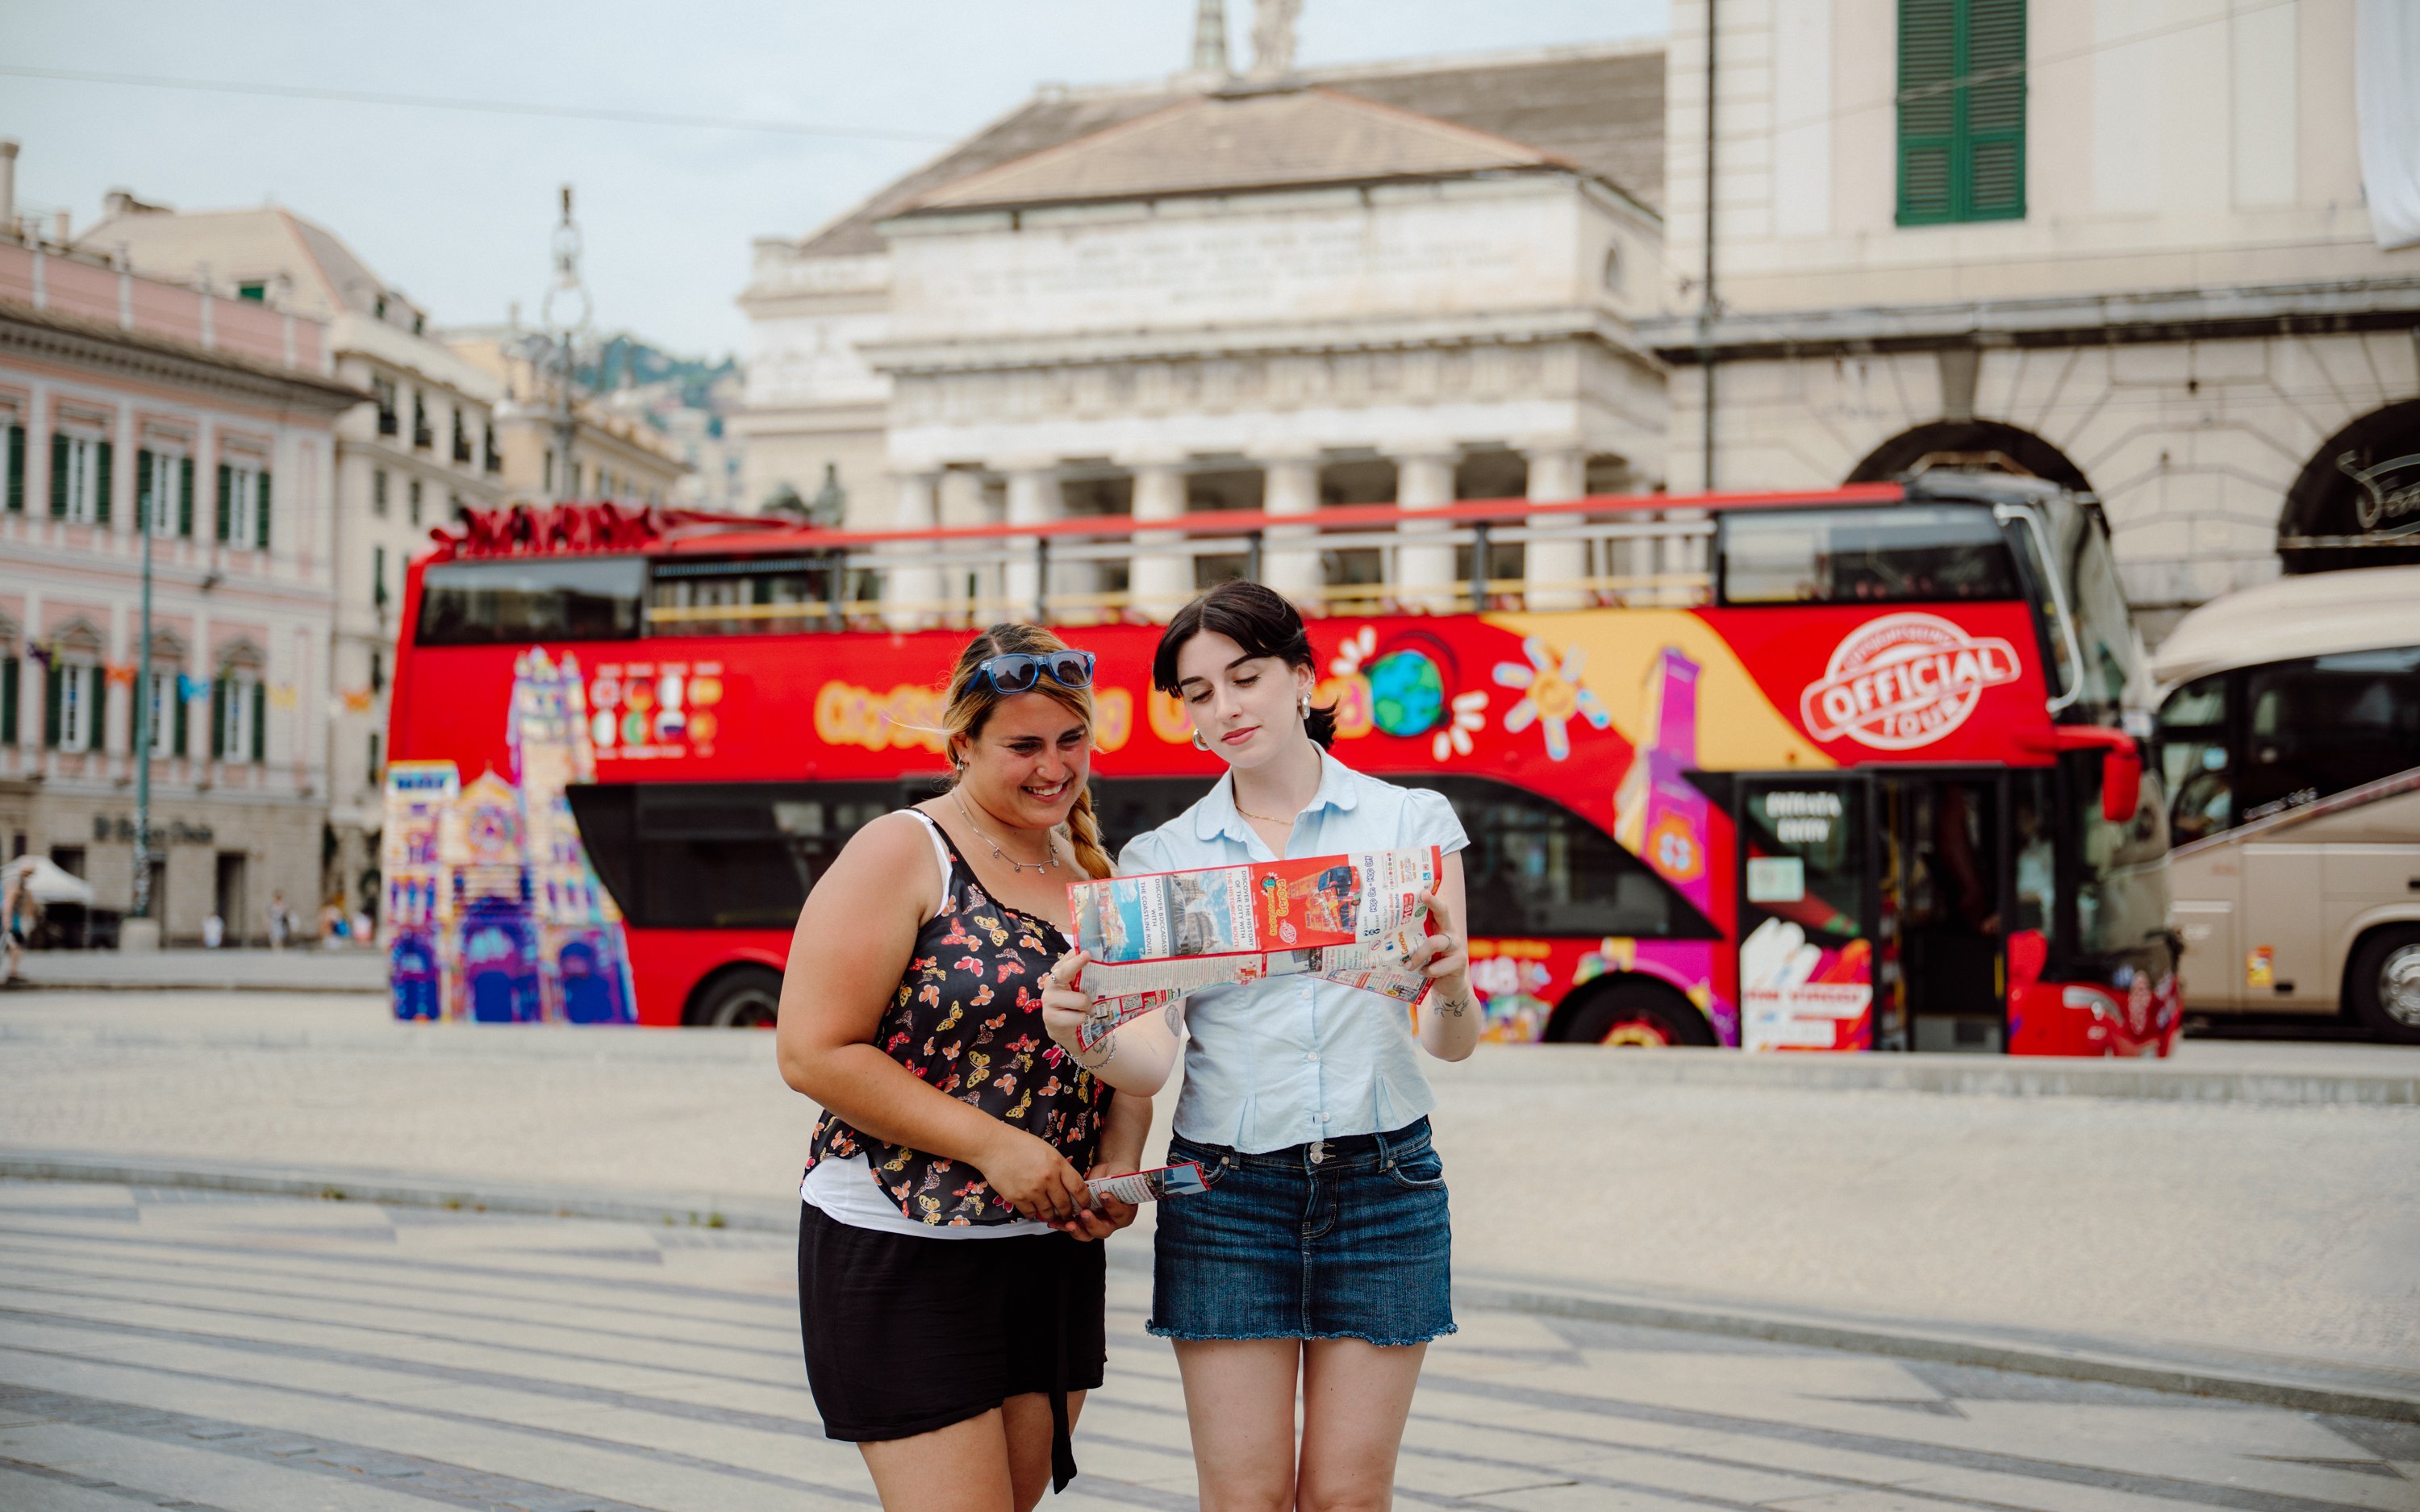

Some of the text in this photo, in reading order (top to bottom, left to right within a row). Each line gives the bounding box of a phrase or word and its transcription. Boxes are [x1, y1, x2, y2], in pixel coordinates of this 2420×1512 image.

[1822, 648, 2006, 726] OFFICIAL
[1883, 695, 1963, 738] TOUR
[1365, 856, 1373, 867] Off
[1366, 868, 1375, 882] Hop
[1241, 871, 1250, 902] DISCOVER
[1276, 879, 1288, 916] Genova
[1368, 887, 1376, 898] On
[1142, 897, 1150, 932] COASTLINE
[1155, 879, 1167, 955] DISCOVER BOCCADASSE
[1228, 886, 1237, 924] HISTORICAL
[1370, 898, 1378, 912] Hop
[1398, 931, 1408, 955] Genova
